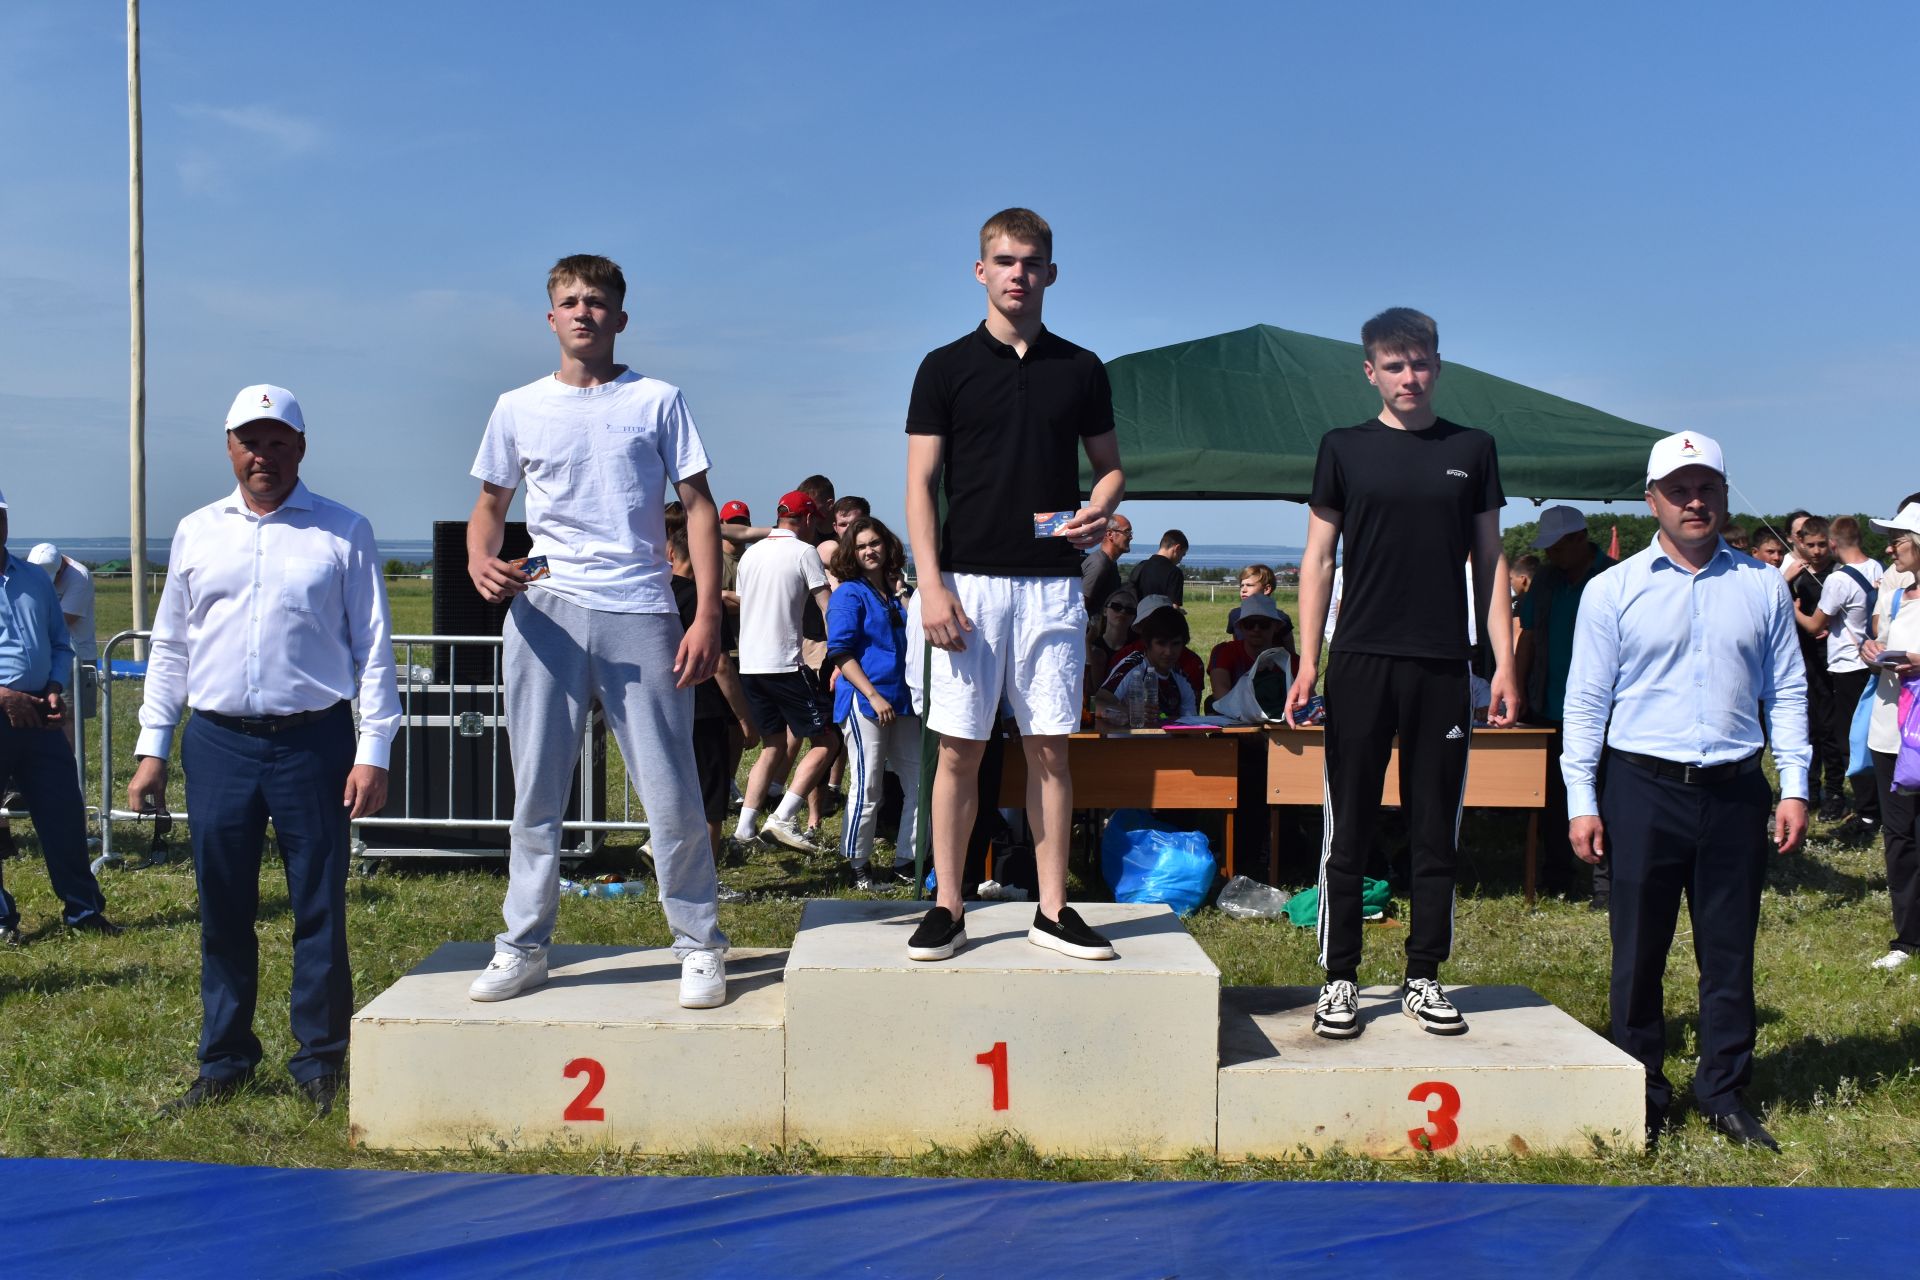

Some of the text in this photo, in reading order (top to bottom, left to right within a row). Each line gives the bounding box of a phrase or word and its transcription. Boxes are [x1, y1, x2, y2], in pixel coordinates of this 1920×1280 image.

[563, 1057, 606, 1122] 2
[975, 1041, 1009, 1111] 1
[1407, 1081, 1461, 1151] 3
